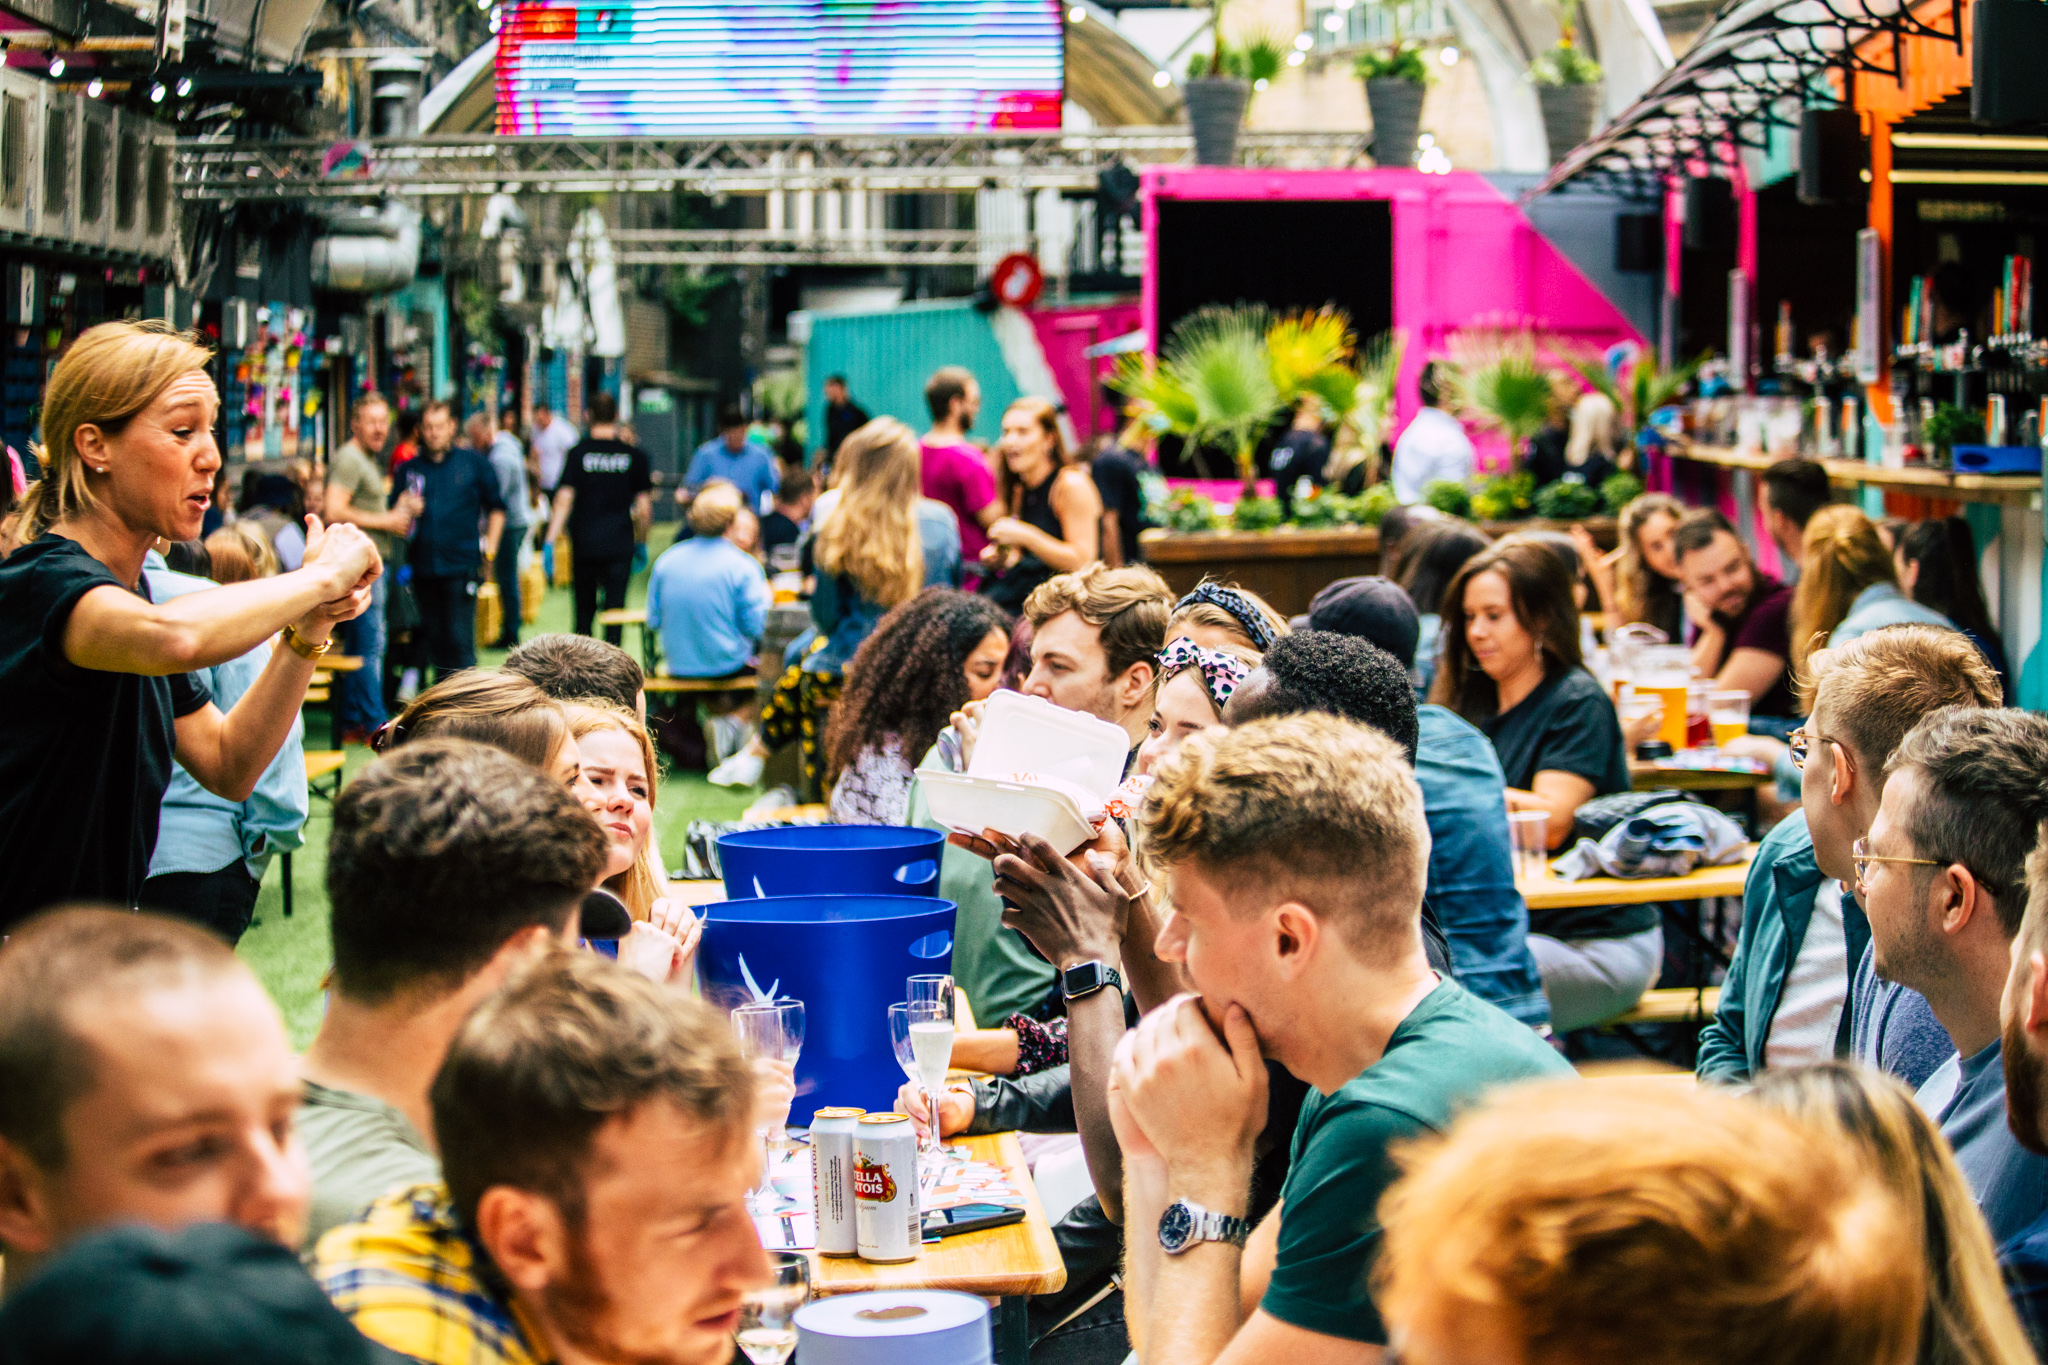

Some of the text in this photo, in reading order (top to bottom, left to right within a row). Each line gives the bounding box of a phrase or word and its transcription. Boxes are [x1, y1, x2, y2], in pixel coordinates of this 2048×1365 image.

[583, 453, 631, 473] STAFF
[854, 1170, 882, 1183] TELLA
[854, 1181, 883, 1194] RTOIS
